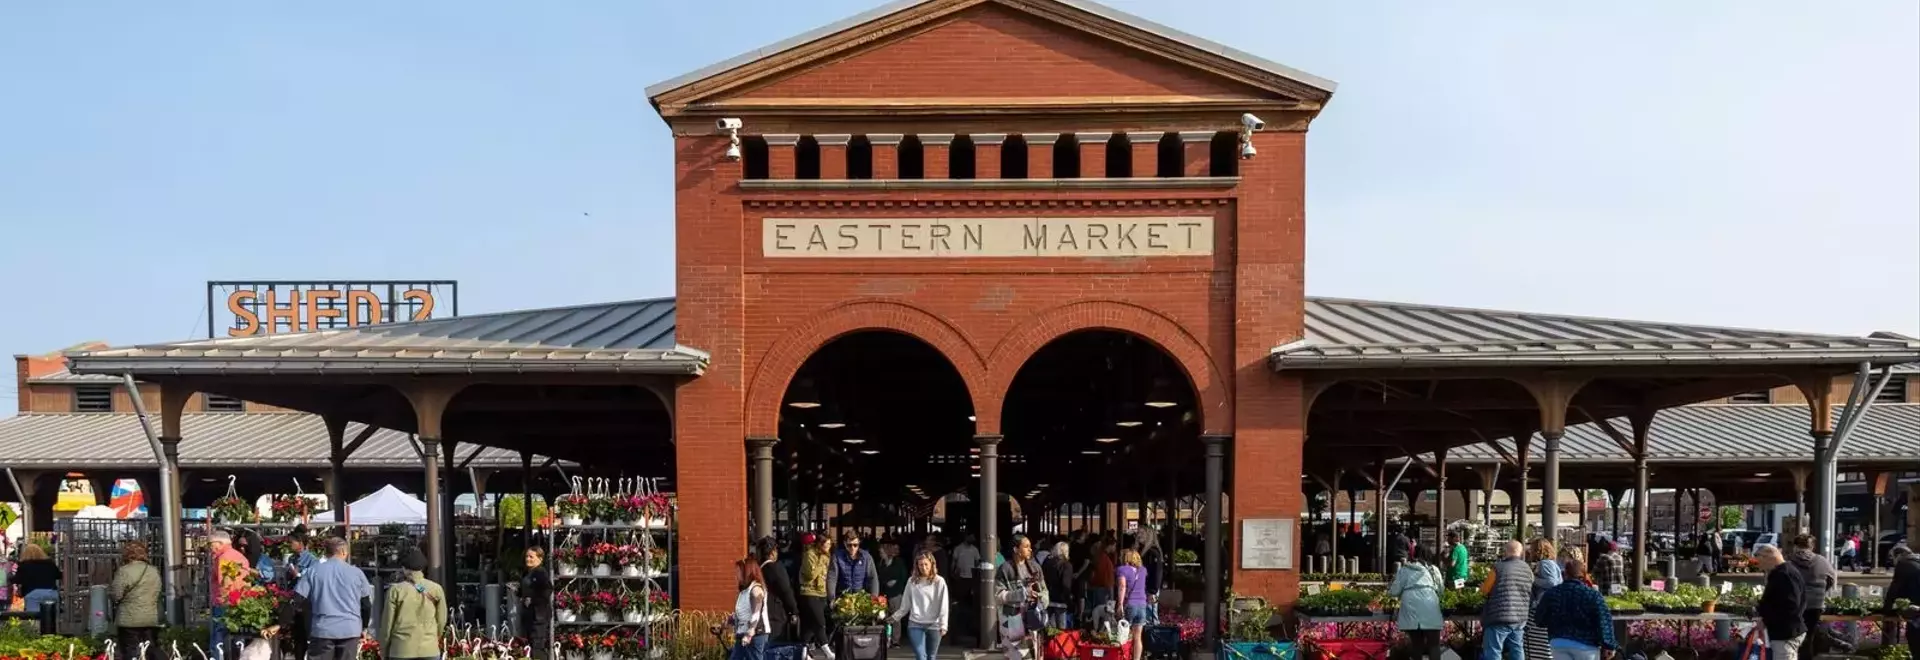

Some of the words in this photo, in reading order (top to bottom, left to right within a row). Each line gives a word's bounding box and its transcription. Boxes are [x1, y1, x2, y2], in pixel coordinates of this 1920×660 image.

[775, 223, 983, 251] EASTERN
[1022, 223, 1209, 251] MARKET
[228, 289, 381, 336] SHED
